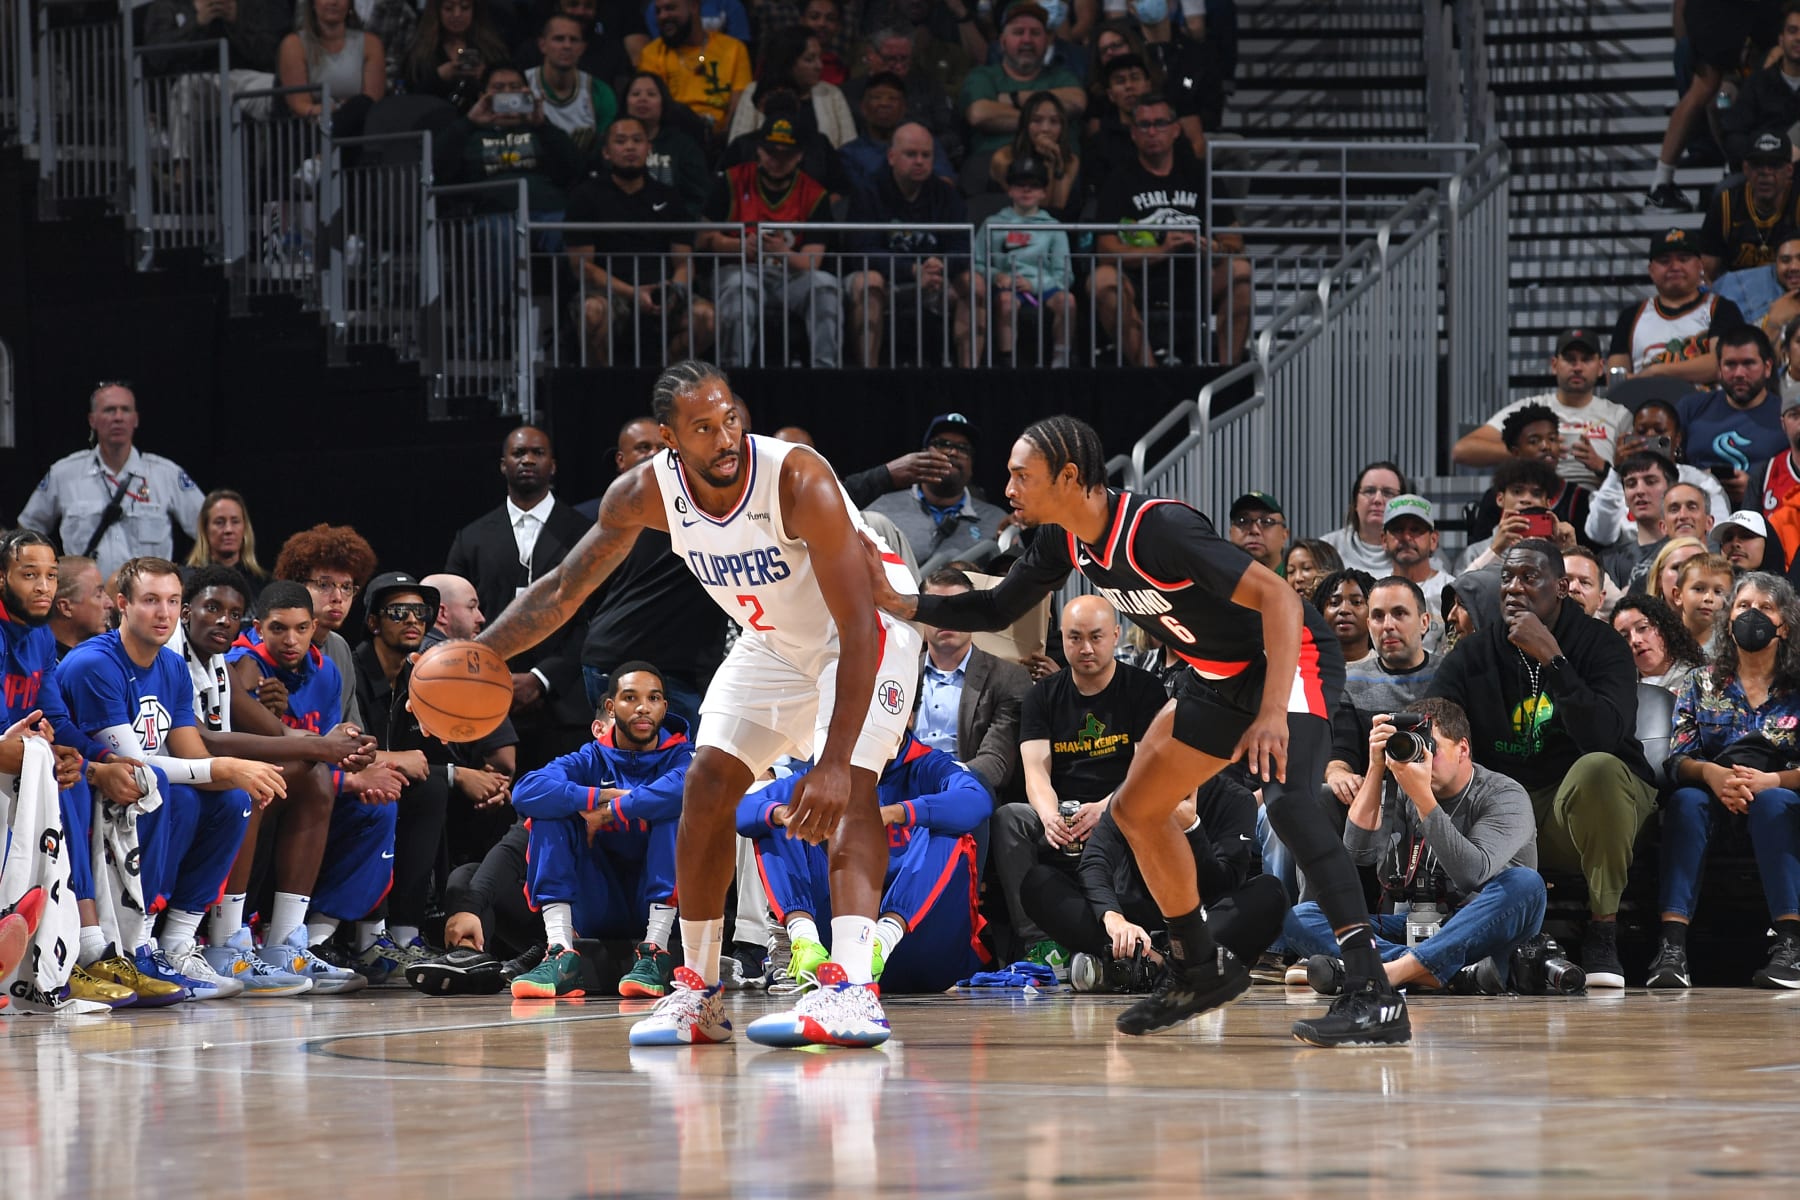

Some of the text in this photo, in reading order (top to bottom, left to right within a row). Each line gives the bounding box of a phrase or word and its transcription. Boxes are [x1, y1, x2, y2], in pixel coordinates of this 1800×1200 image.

[1132, 190, 1198, 211] PEARL JAM
[688, 546, 791, 587] CLIPPERS
[736, 595, 776, 631] 2
[1160, 615, 1197, 644] 6
[1053, 733, 1129, 754] SHAWN KEMP'S
[1089, 745, 1117, 758] CANNABIS
